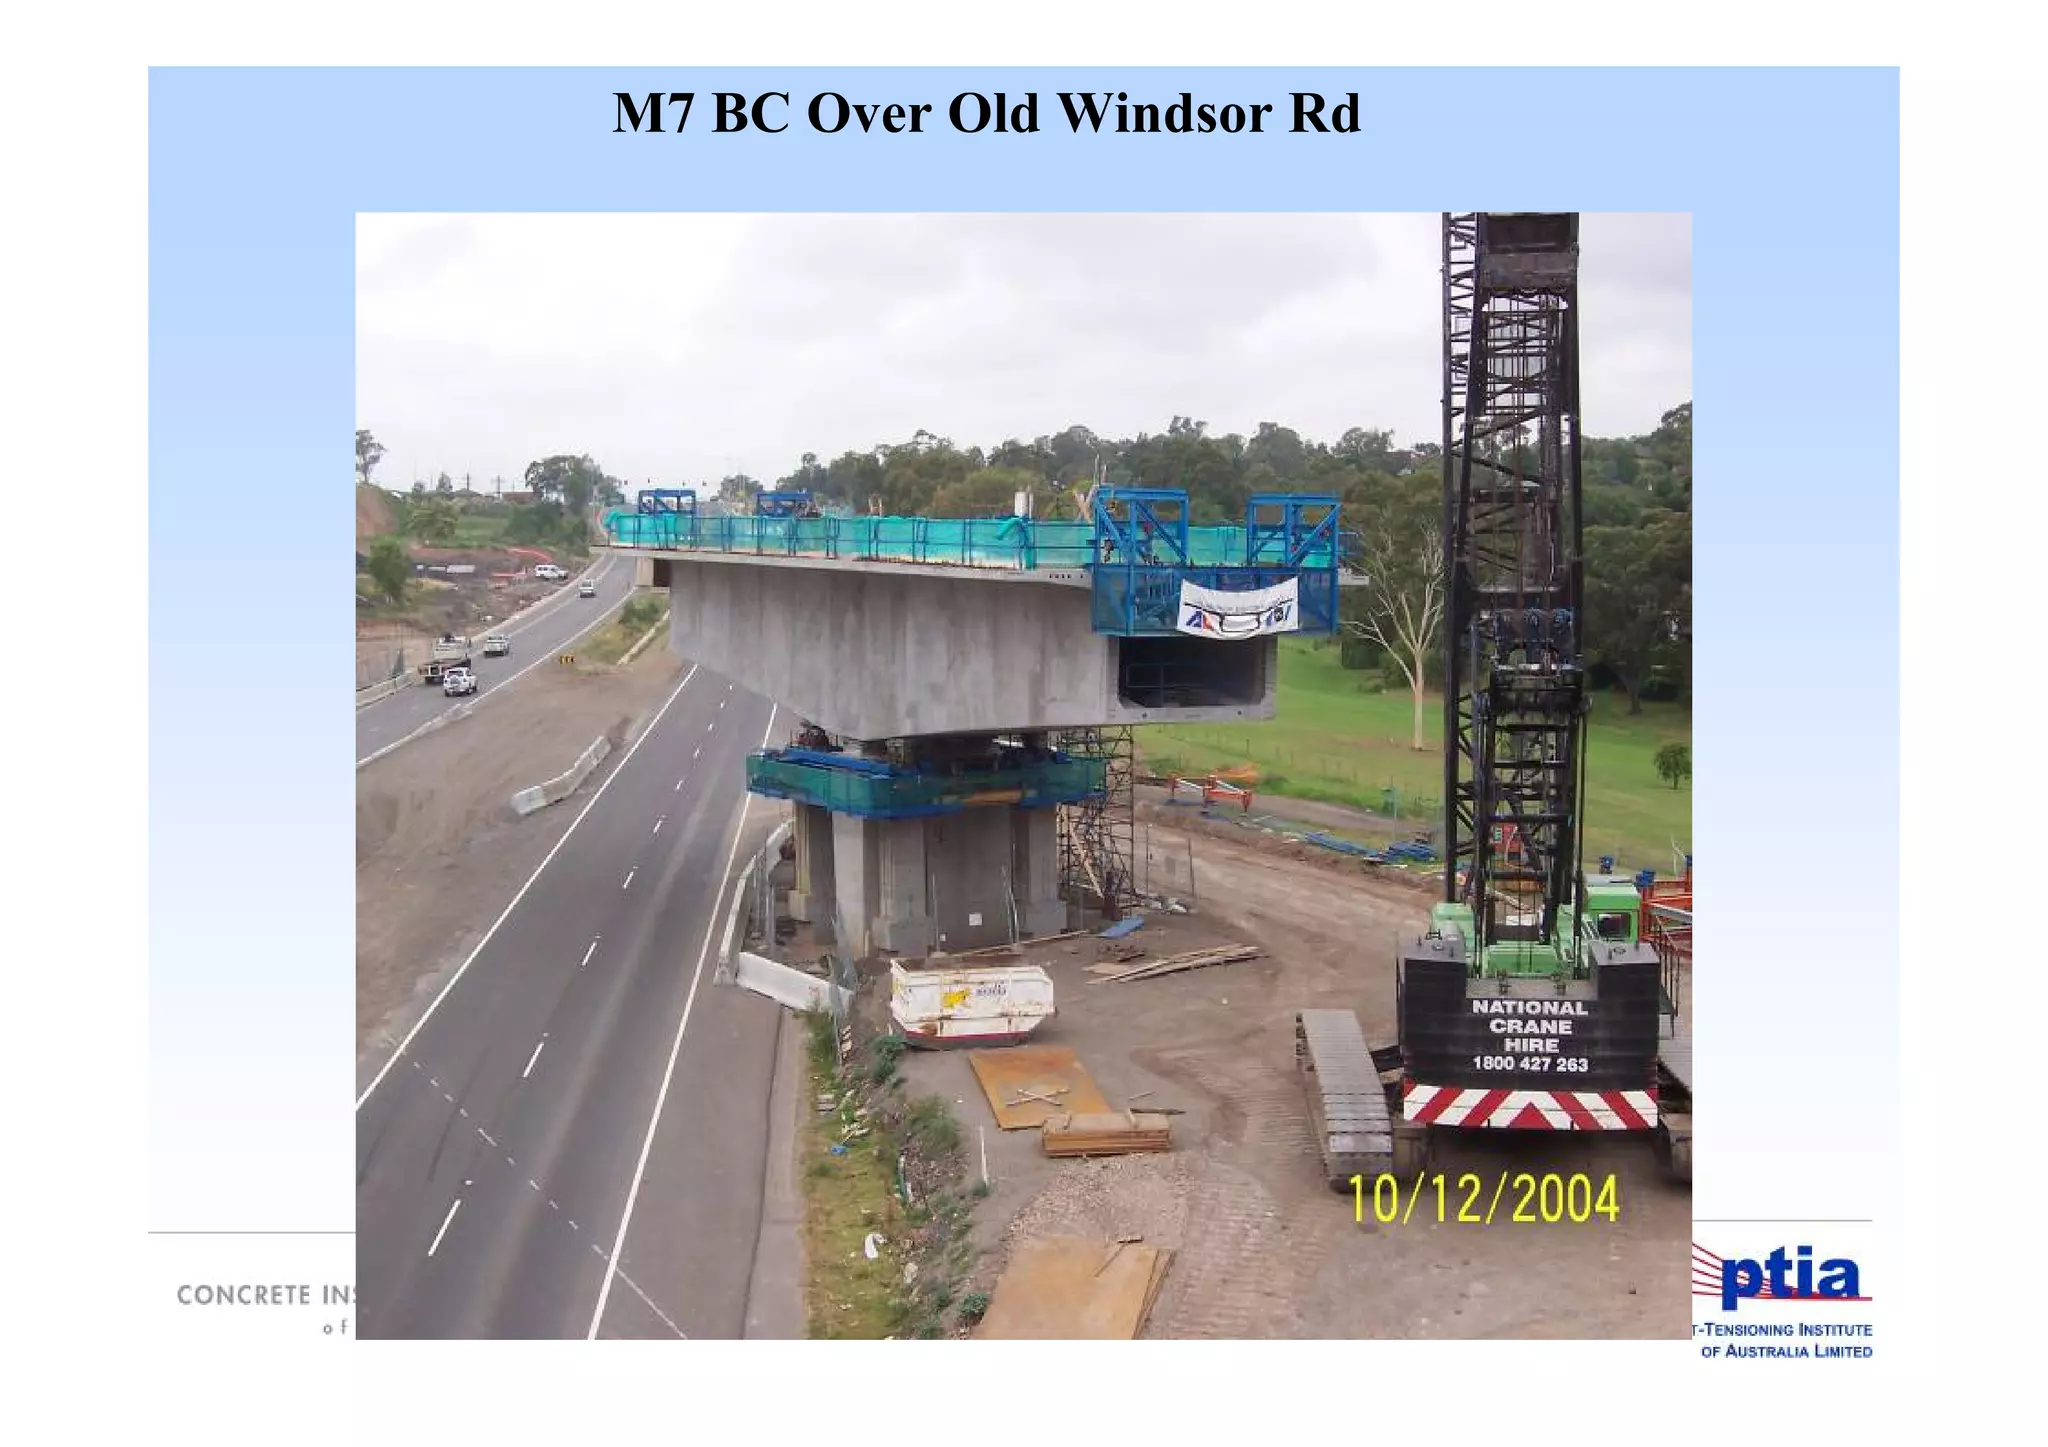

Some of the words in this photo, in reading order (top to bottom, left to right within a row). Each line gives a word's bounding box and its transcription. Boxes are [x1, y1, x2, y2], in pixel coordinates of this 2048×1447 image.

[1472, 999, 1589, 1016] NATIONAL
[1489, 1017, 1573, 1035] CRANE
[1503, 1037, 1560, 1054] HIRE
[1473, 1055, 1516, 1071] 1800
[1519, 1056, 1552, 1072] 427
[1556, 1057, 1589, 1073] 263
